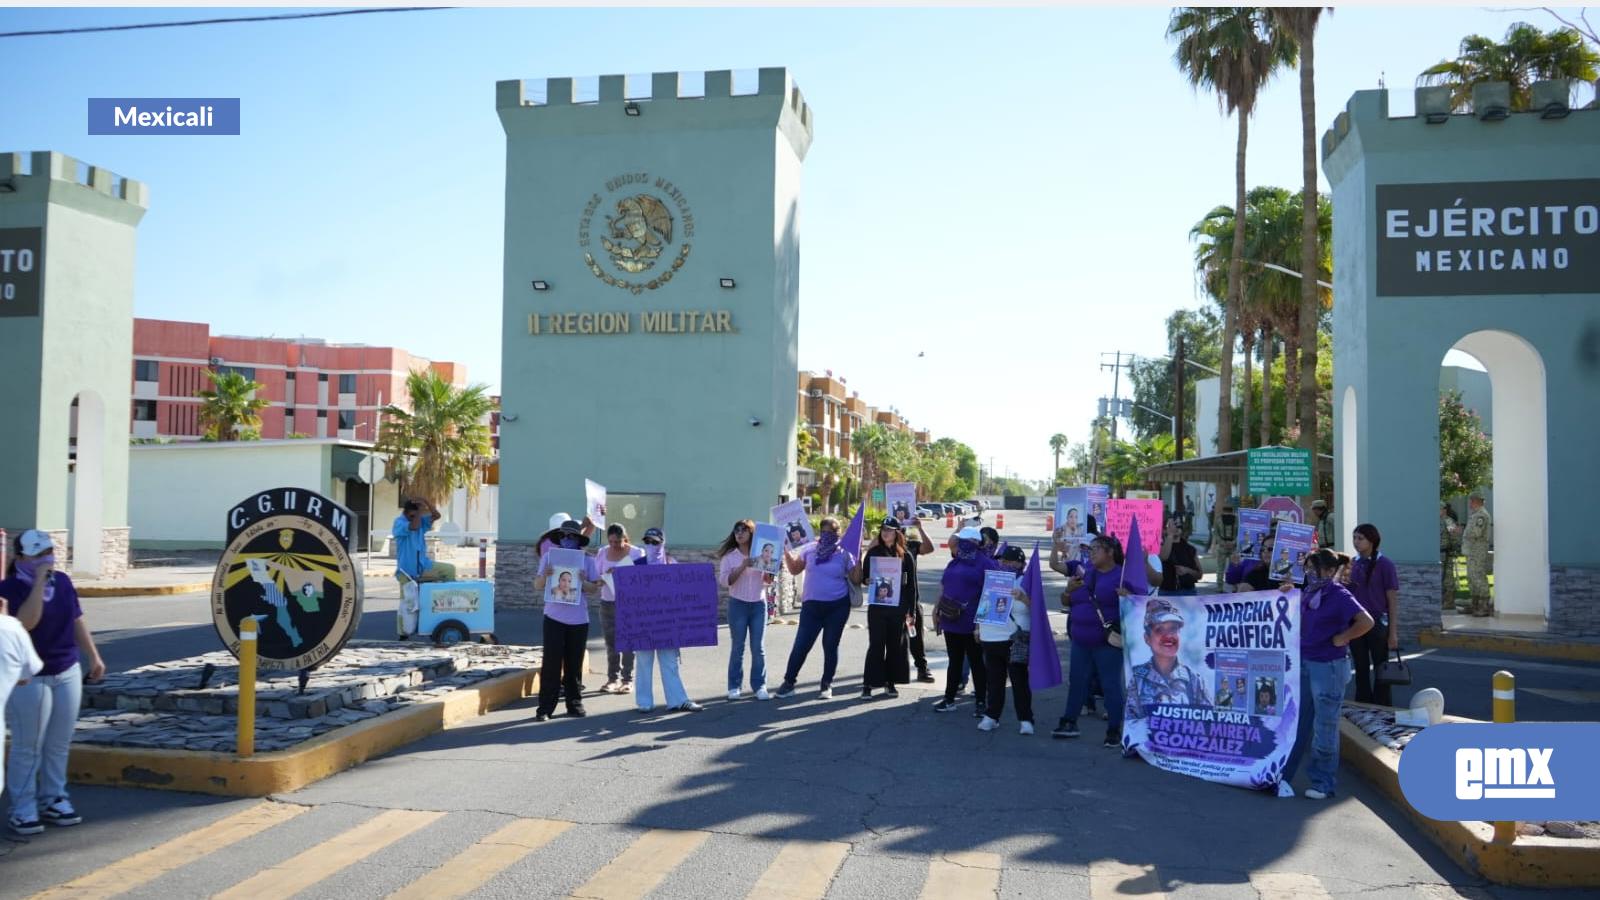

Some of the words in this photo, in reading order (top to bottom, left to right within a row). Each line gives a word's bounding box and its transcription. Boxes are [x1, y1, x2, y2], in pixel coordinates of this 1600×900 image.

[578, 192, 602, 247] ESTADOS
[604, 172, 648, 193] UNIDOS
[655, 175, 695, 239] MEXICANOS
[1385, 197, 1599, 238] EJÉRCITO
[1415, 247, 1569, 272] MEXICANO
[527, 312, 540, 335] II
[549, 312, 630, 335] REGION
[231, 507, 250, 530] C.
[257, 494, 275, 513] G.
[284, 491, 296, 510] II
[306, 496, 323, 518] R.
[331, 507, 349, 541] M.
[1204, 600, 1274, 623] MARCHA
[1205, 621, 1286, 649] PACÍFICA
[1152, 706, 1214, 721] JUSTICIA
[1217, 712, 1250, 725] PARA
[1150, 716, 1206, 735] ERTHA
[1209, 722, 1262, 743] MIREYA
